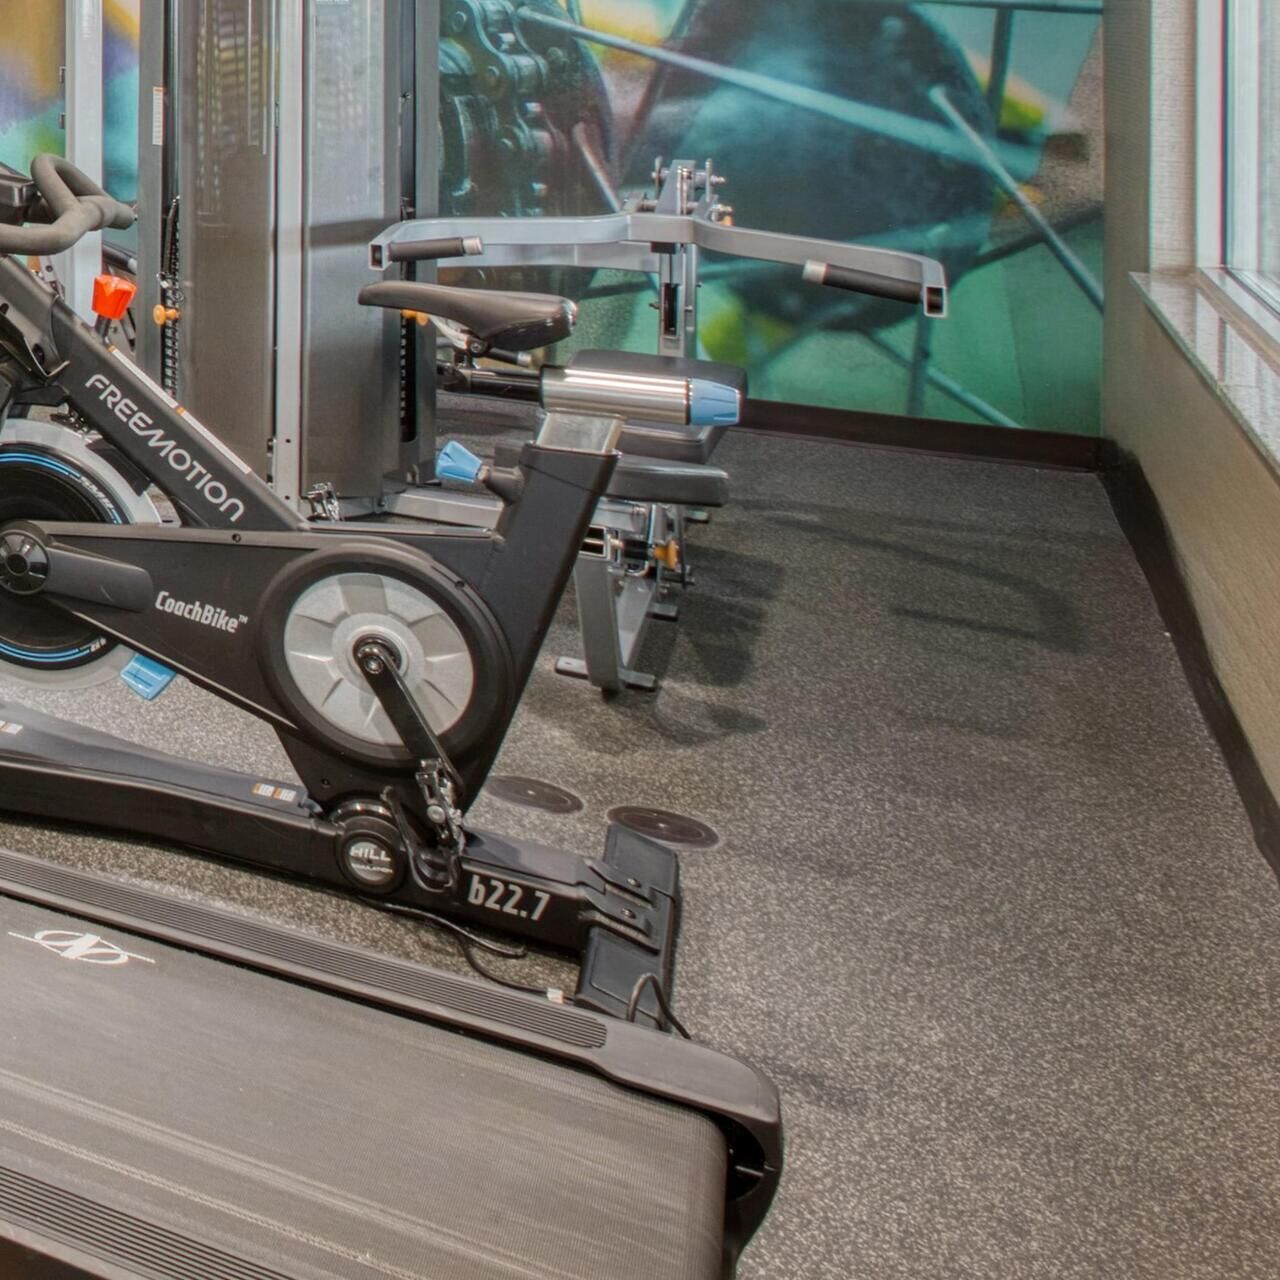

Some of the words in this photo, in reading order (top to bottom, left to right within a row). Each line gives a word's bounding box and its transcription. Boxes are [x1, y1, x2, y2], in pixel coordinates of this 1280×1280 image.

[85, 373, 245, 523] FREEMOTION
[350, 846, 391, 861] HILL
[467, 874, 551, 922] b22.7
